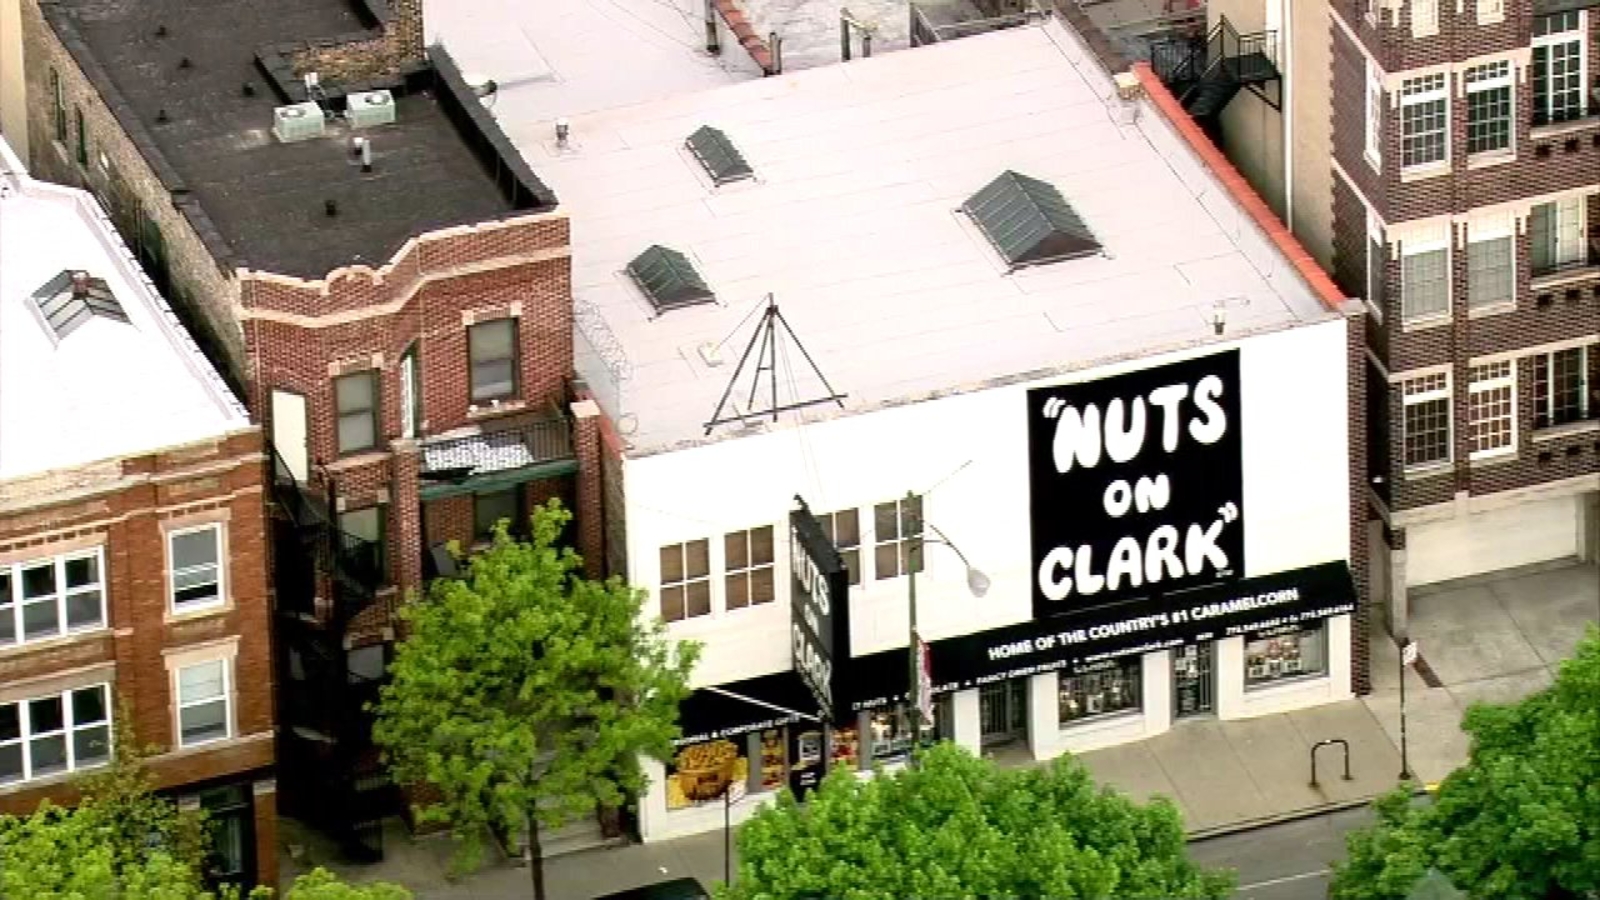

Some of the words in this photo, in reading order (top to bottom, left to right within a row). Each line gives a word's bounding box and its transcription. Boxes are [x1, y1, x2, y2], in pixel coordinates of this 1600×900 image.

[1103, 473, 1171, 518] ON
[988, 640, 1033, 660] HOME
[1035, 635, 1057, 650] OF
[1058, 629, 1088, 646] THE
[1088, 612, 1170, 640] COUNTRY'S
[1191, 587, 1300, 620] CARAMELCORN
